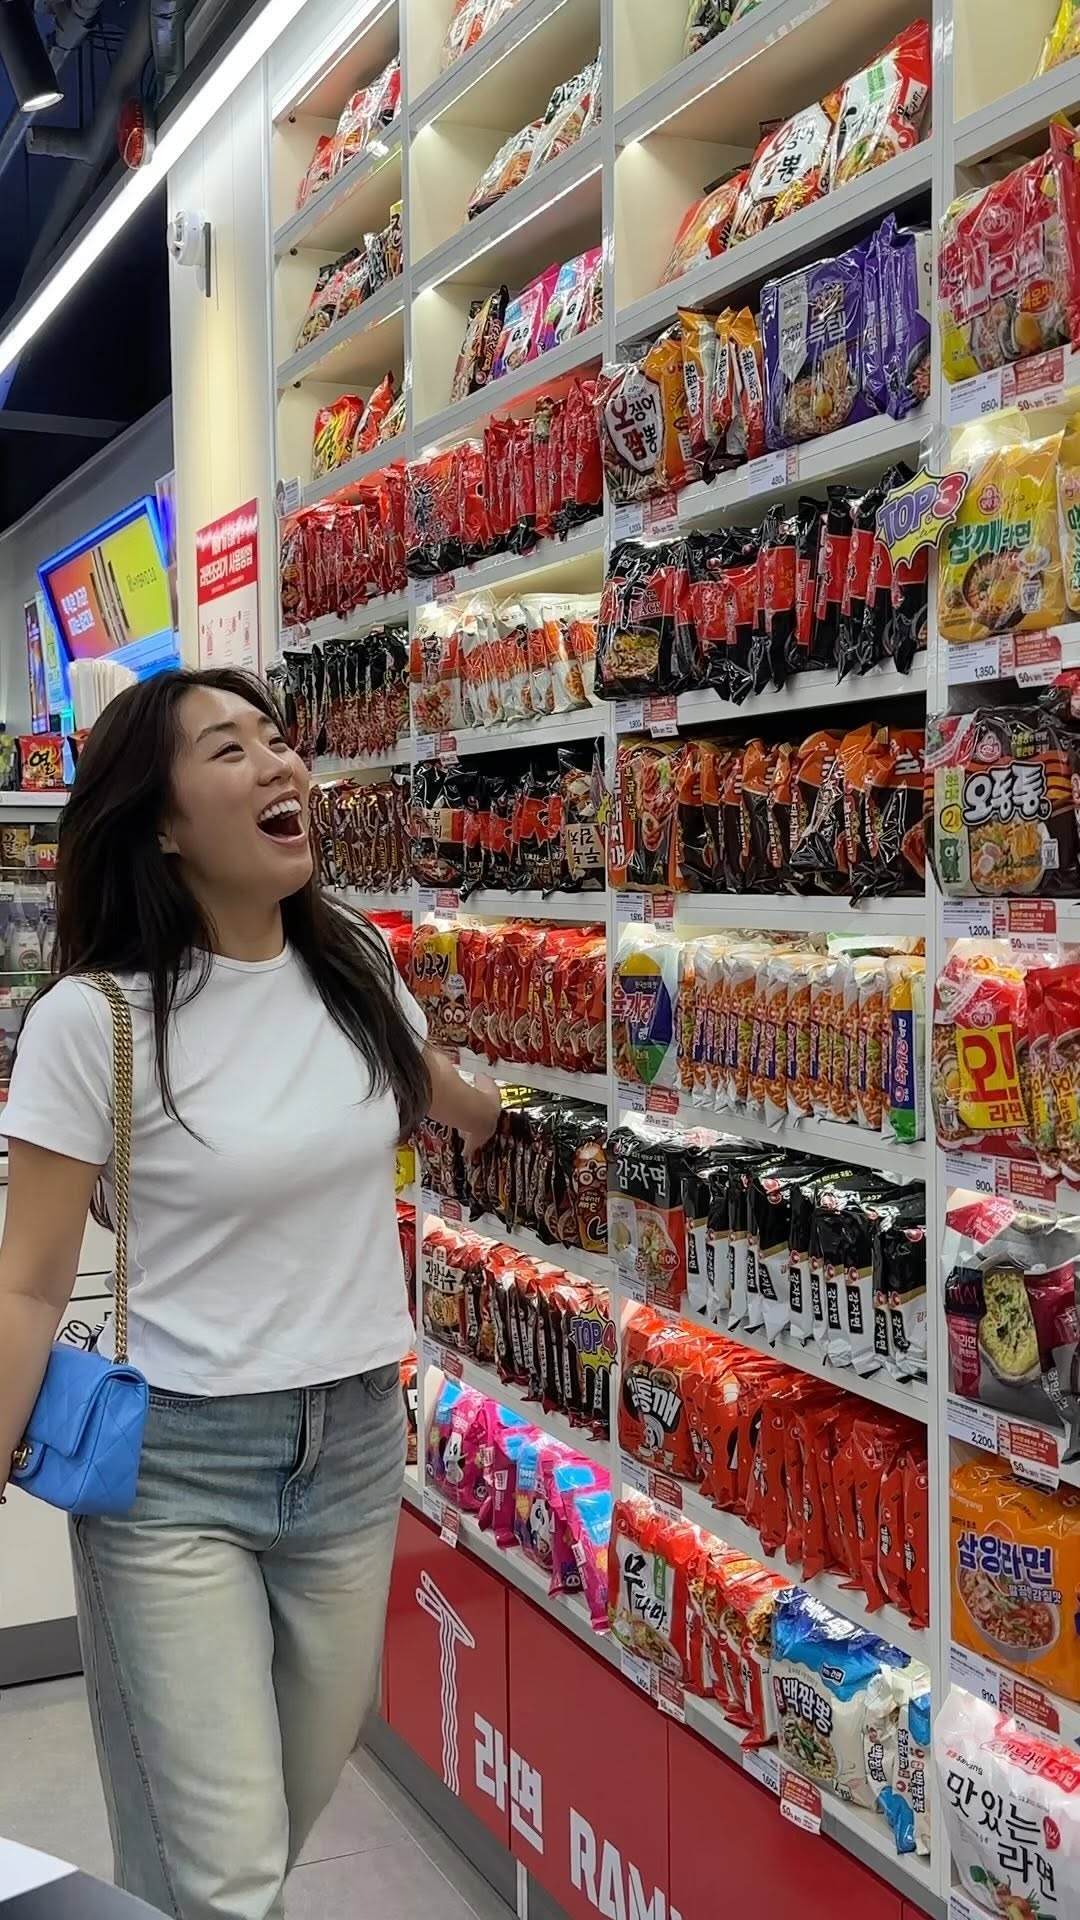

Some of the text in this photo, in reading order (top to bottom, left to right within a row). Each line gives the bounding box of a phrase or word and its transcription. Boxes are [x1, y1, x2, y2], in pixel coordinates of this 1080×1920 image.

[949, 518, 1031, 565] 참깨라면
[895, 1018, 909, 1086] 육개장라면
[989, 1103, 1025, 1122] 라면
[616, 1158, 667, 1197] 감자면
[957, 1531, 1053, 1586] 삼양라면
[782, 1678, 833, 1738] 백짬뽕
[475, 1711, 544, 1856] 라면
[947, 1768, 1041, 1846] 맛있는
[997, 1842, 1057, 1902] 라면
